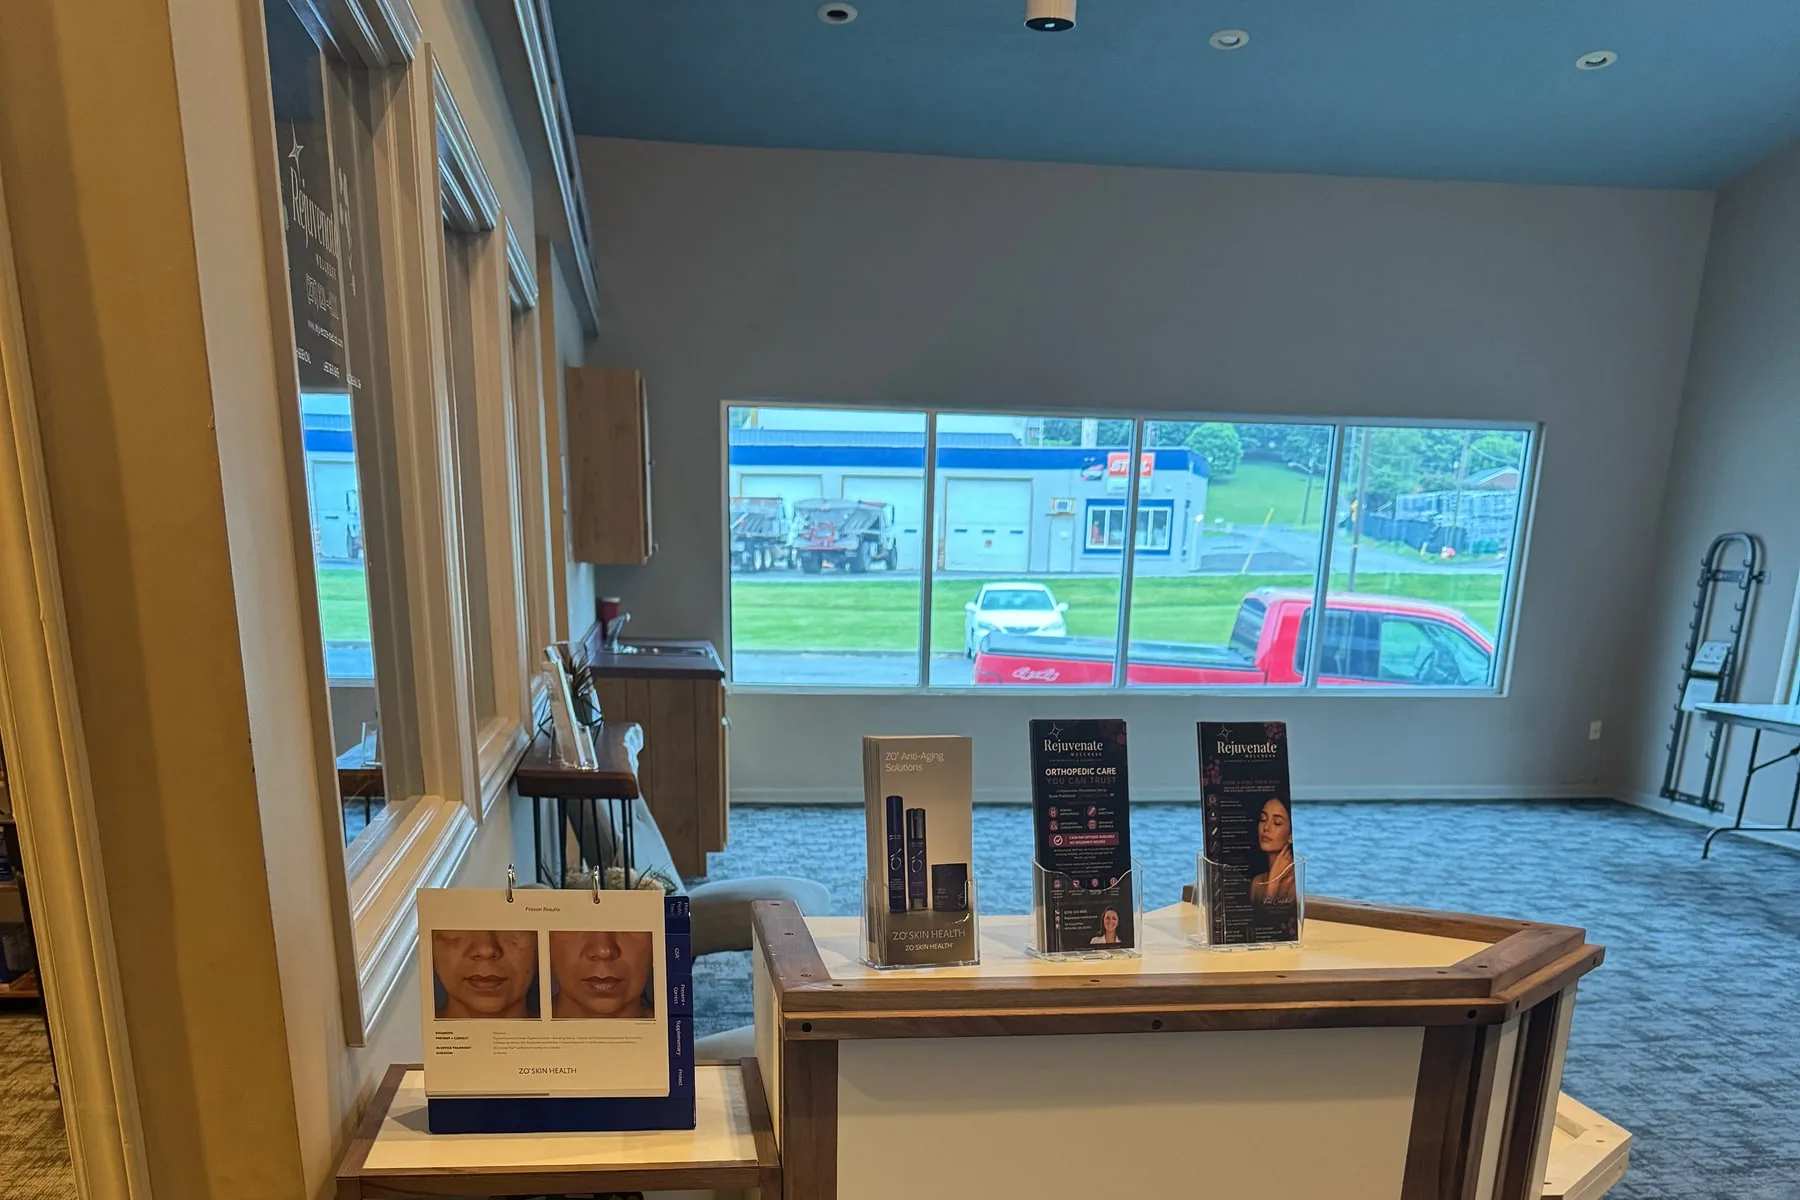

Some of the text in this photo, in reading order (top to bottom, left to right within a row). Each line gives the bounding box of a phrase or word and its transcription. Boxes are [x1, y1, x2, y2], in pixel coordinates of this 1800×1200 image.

[1044, 739, 1103, 753] Rejuvenate
[1217, 741, 1278, 756] Rejuvenate
[900, 751, 944, 763] Anti-Aging
[885, 763, 923, 772] Solutions
[1045, 767, 1117, 776] ORTHOPEDIC CARE
[1046, 776, 1116, 785] YOU CAN TRUST
[909, 930, 929, 940] SKIN
[931, 928, 966, 939] HEALTH
[531, 1067, 548, 1075] SKIN
[549, 1067, 577, 1075] HEALTH
